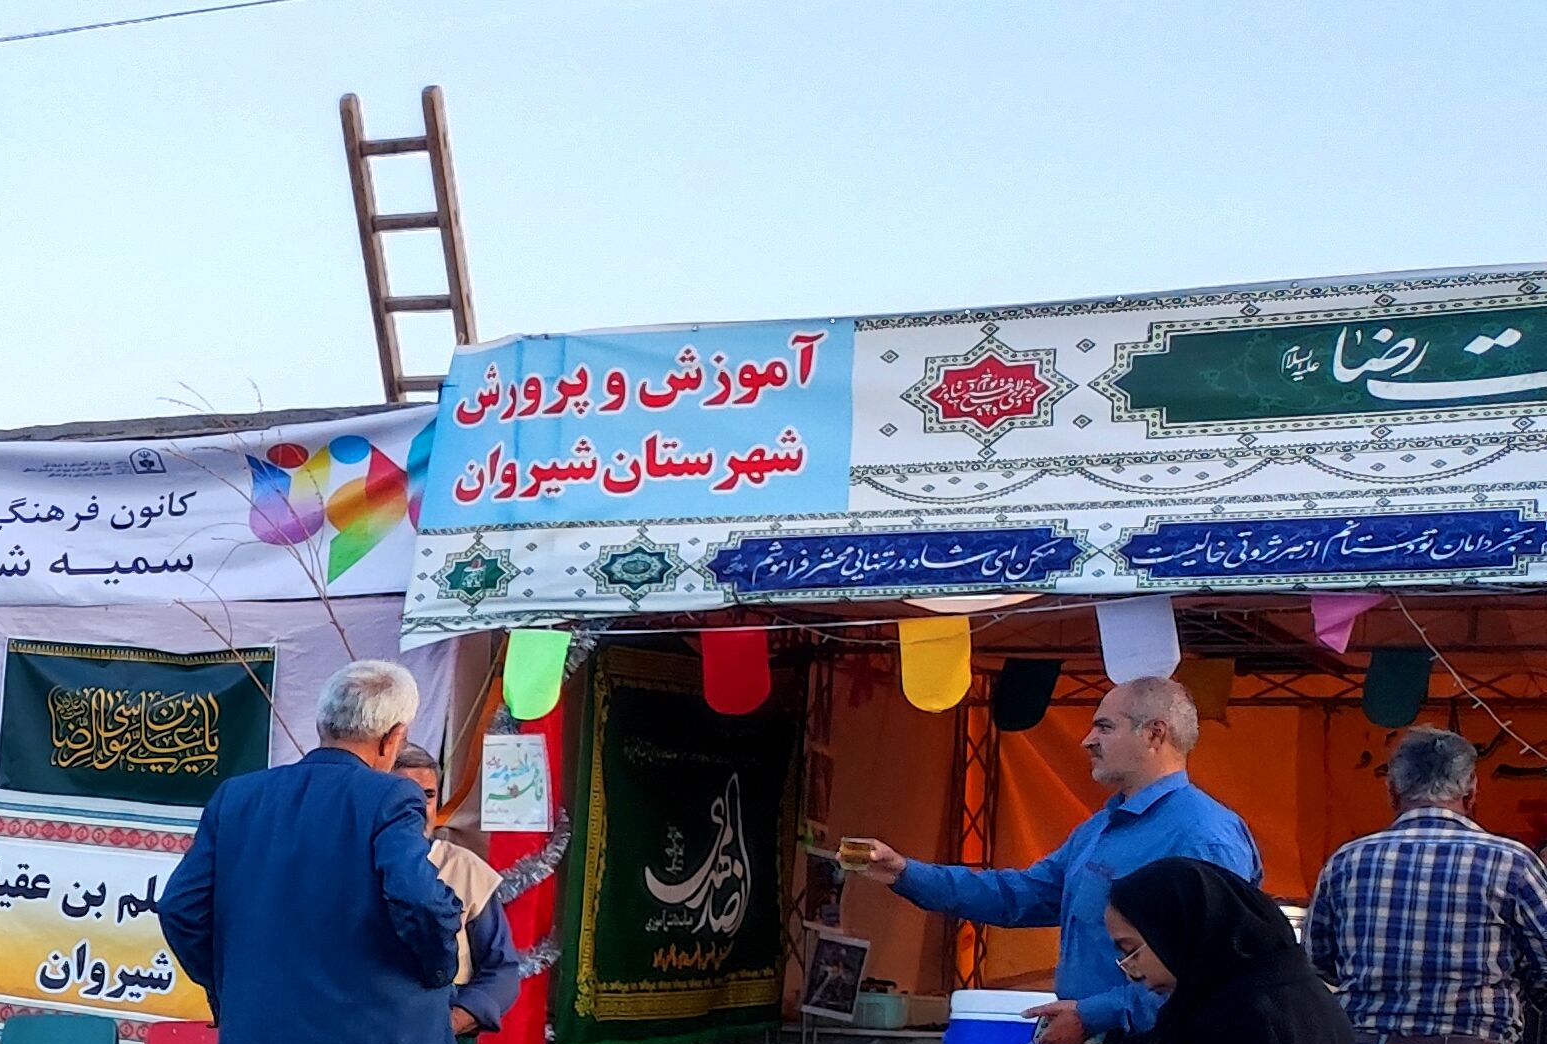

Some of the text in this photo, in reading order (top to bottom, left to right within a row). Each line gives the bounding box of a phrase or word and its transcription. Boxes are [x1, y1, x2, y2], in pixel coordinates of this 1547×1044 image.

[455, 333, 826, 425] آموزش و پرورش
[1332, 325, 1431, 384] رضا
[454, 429, 804, 502] شهرستان شیروان
[110, 490, 198, 530] کانون
[48, 551, 194, 586] سمیه
[61, 881, 107, 920] بن
[115, 874, 161, 924] لم
[38, 941, 173, 999] شیروان
